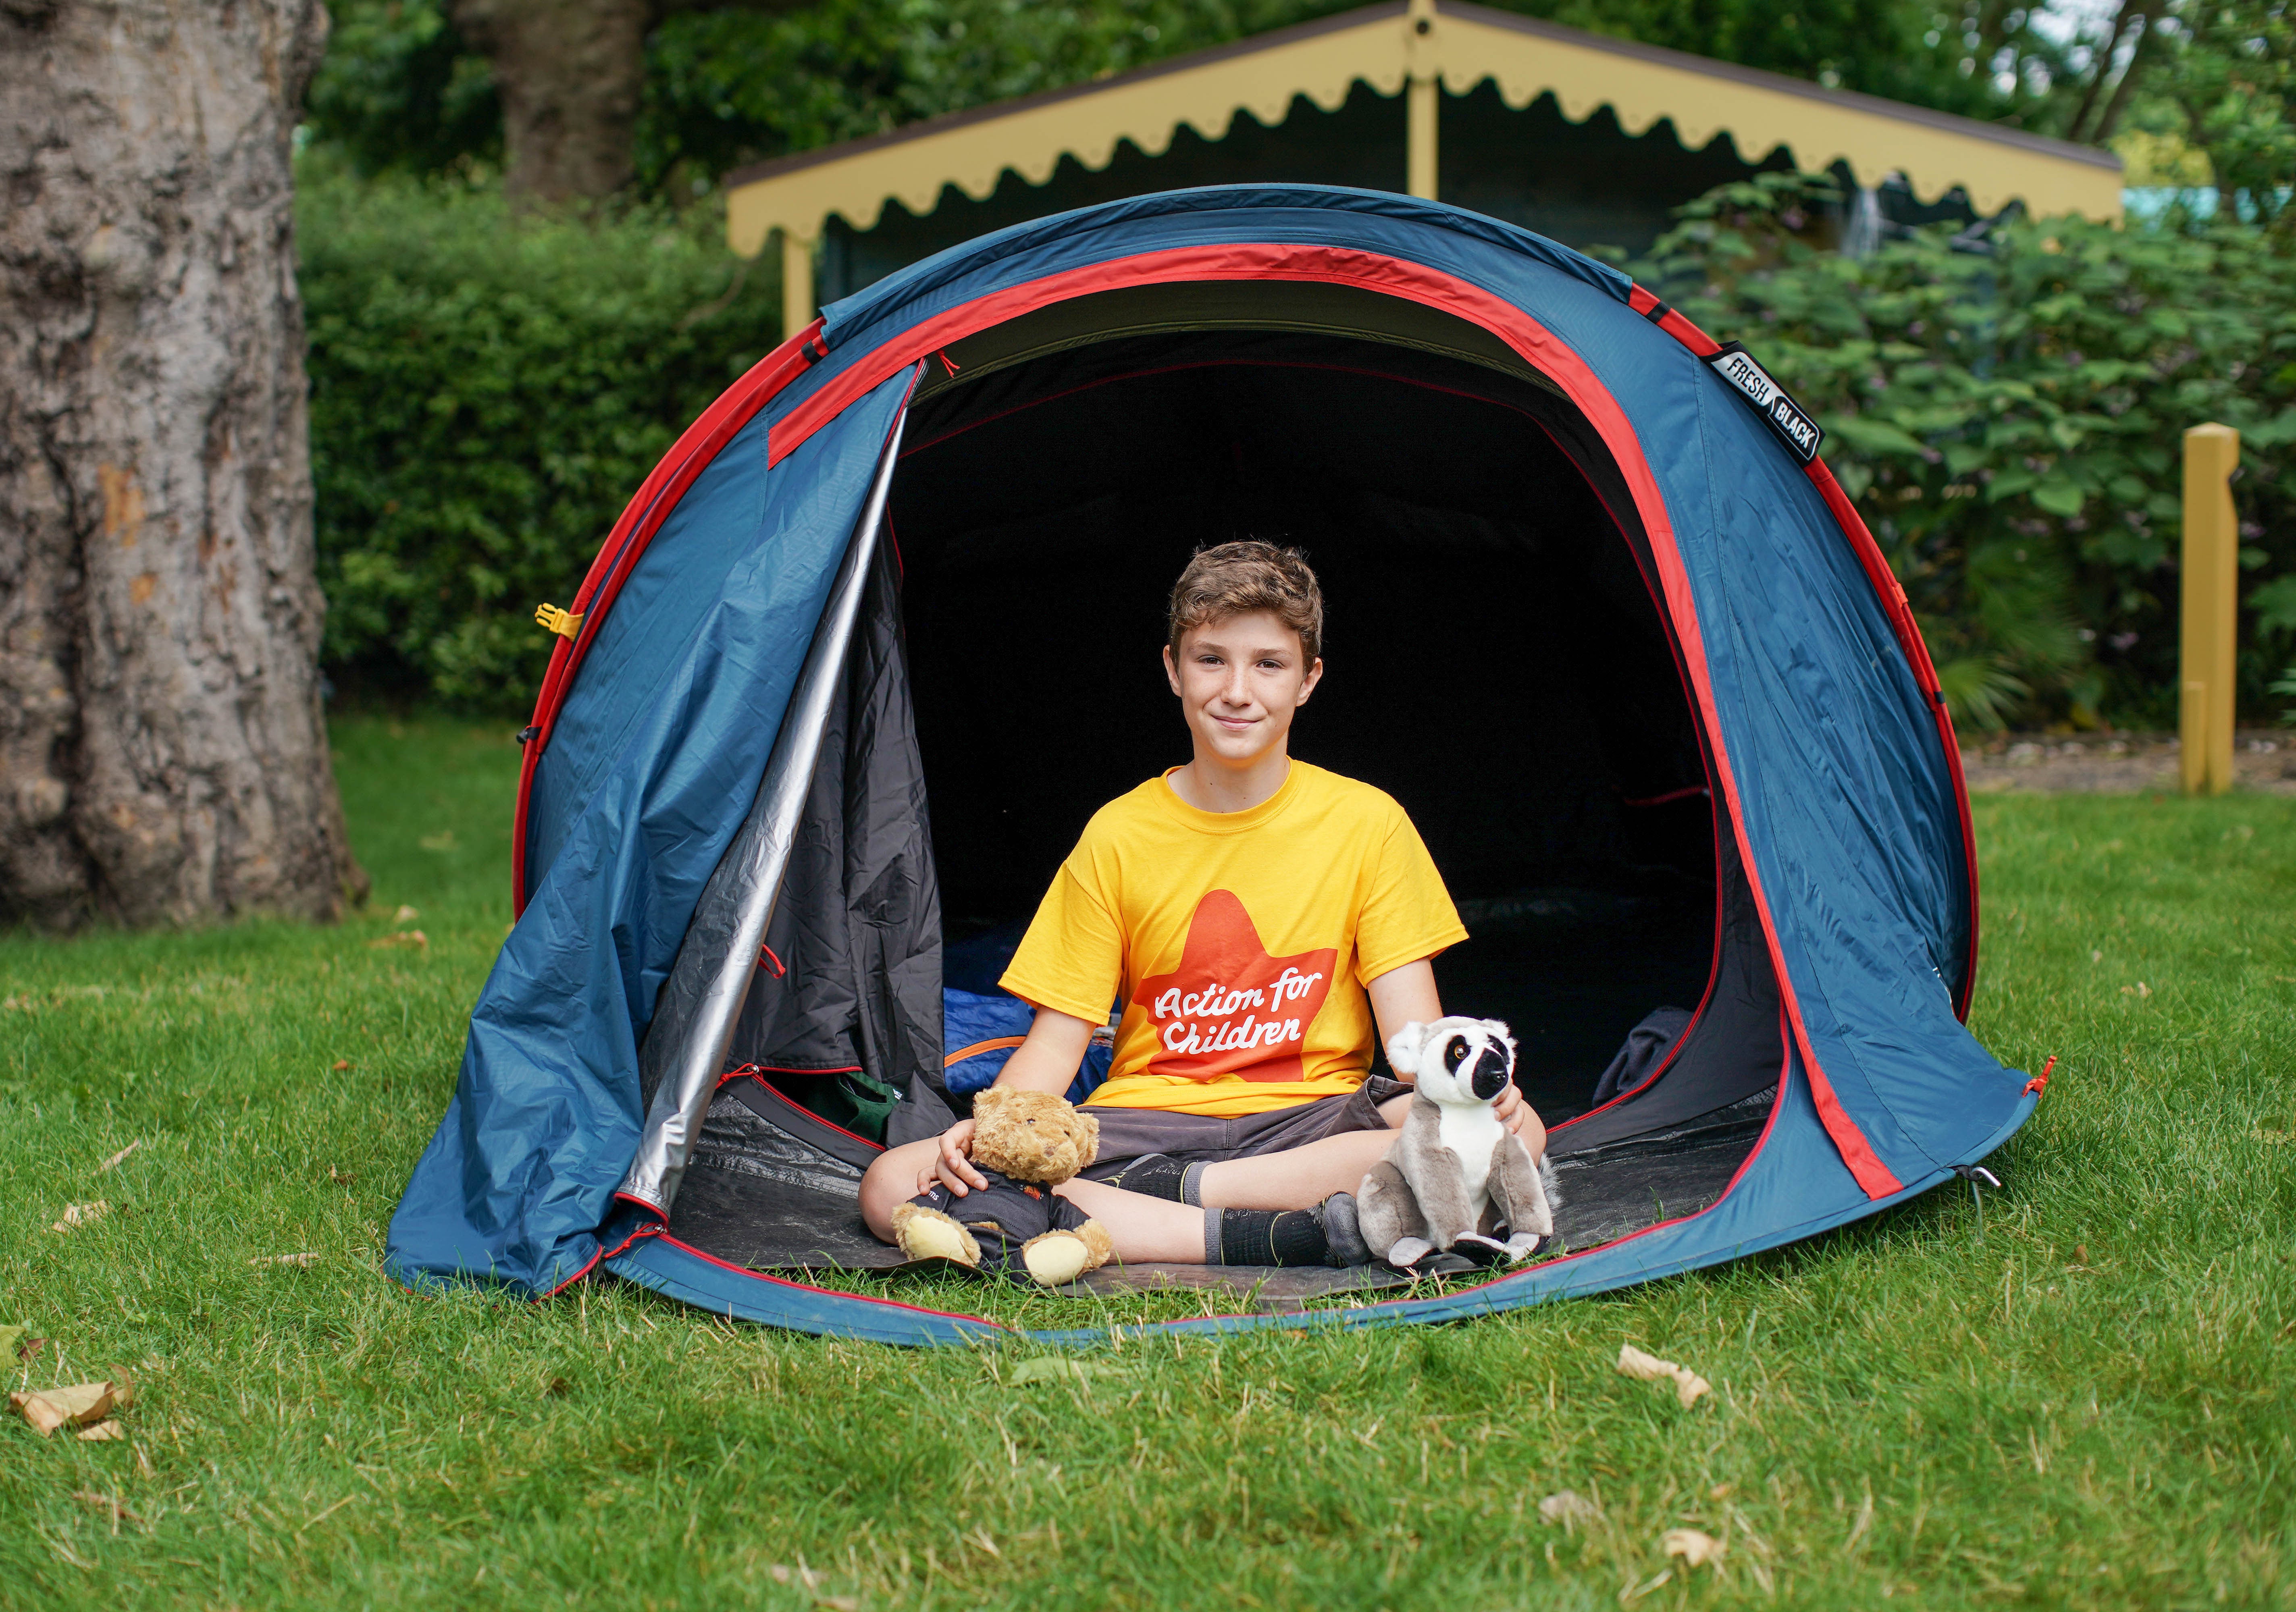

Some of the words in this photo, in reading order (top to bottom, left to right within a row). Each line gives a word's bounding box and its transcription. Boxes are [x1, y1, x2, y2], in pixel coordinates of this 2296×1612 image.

[1727, 357, 1769, 402] FRESH
[1775, 403, 1816, 448] BLACK
[1155, 983, 1264, 1018] Action
[1269, 967, 1322, 1012] for
[1163, 1015, 1300, 1054] Children
